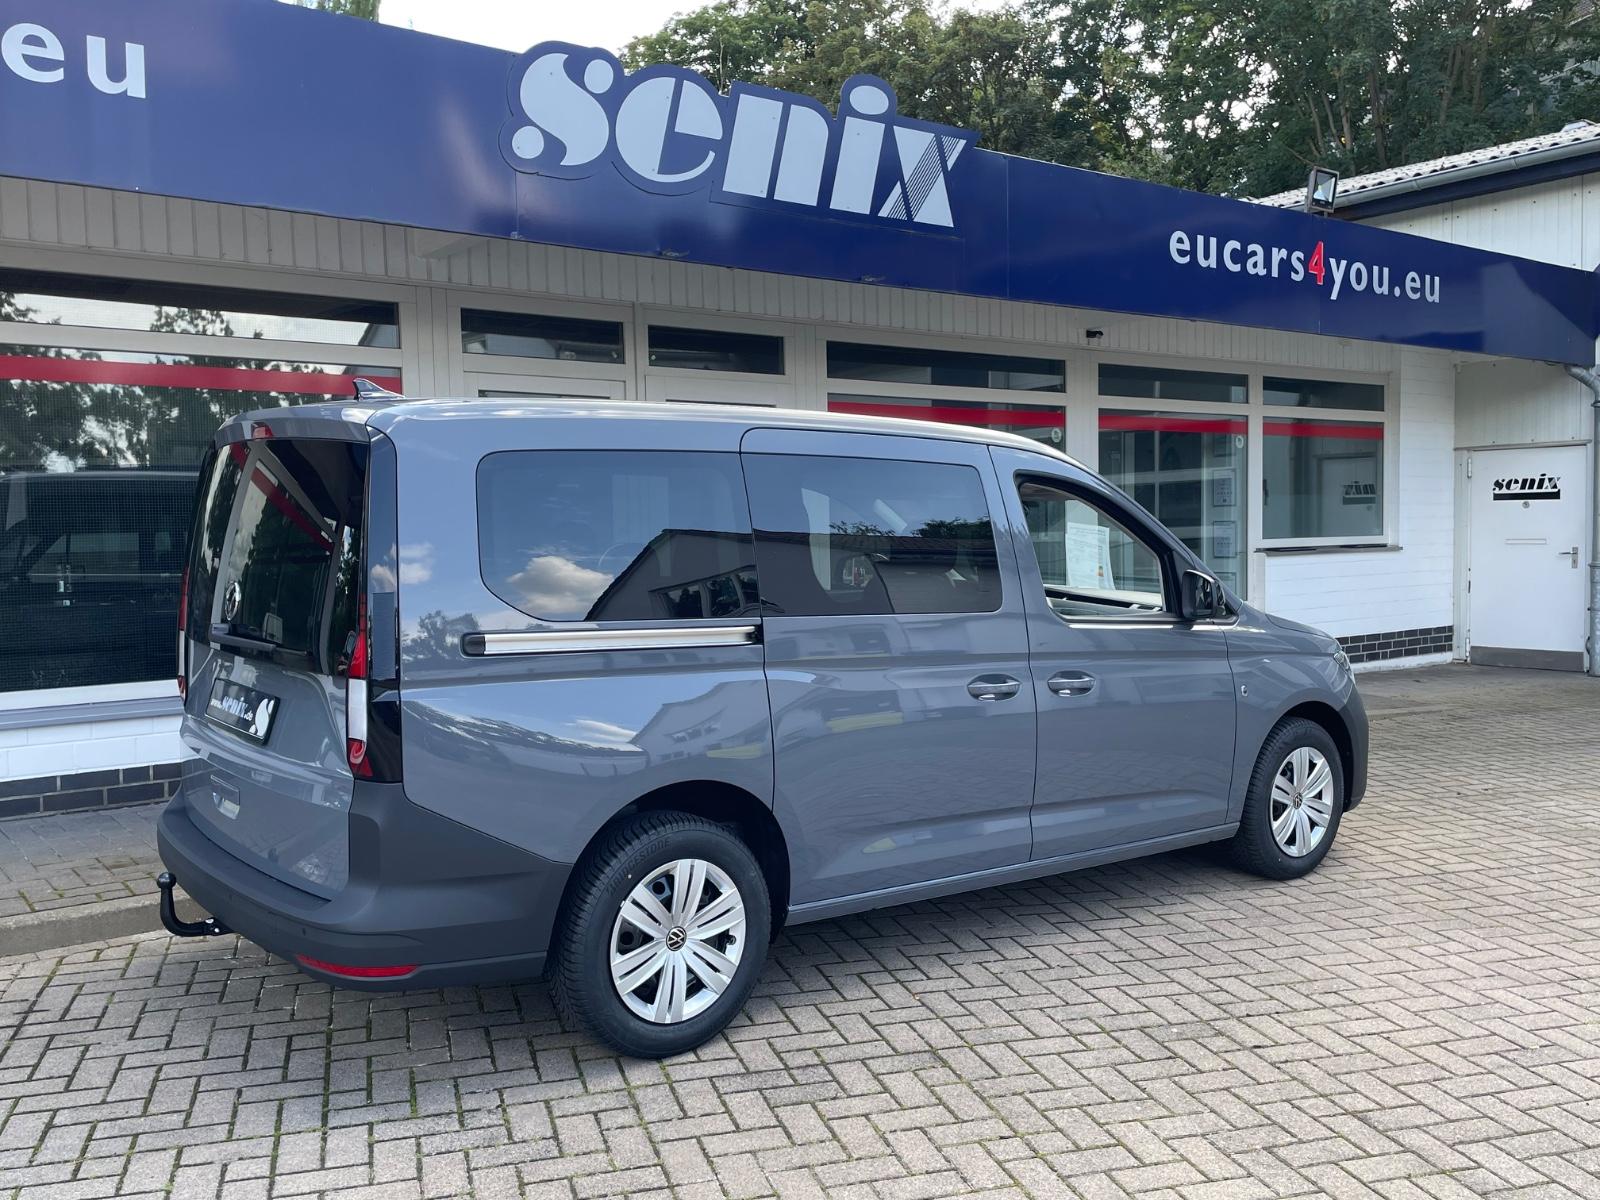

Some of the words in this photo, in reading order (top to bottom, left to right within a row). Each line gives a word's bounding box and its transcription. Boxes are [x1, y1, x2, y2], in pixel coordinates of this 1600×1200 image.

[1, 23, 146, 98] eu
[511, 52, 968, 228] senix
[1169, 230, 1440, 303] eucars4you.eu
[1493, 473, 1561, 491] senix
